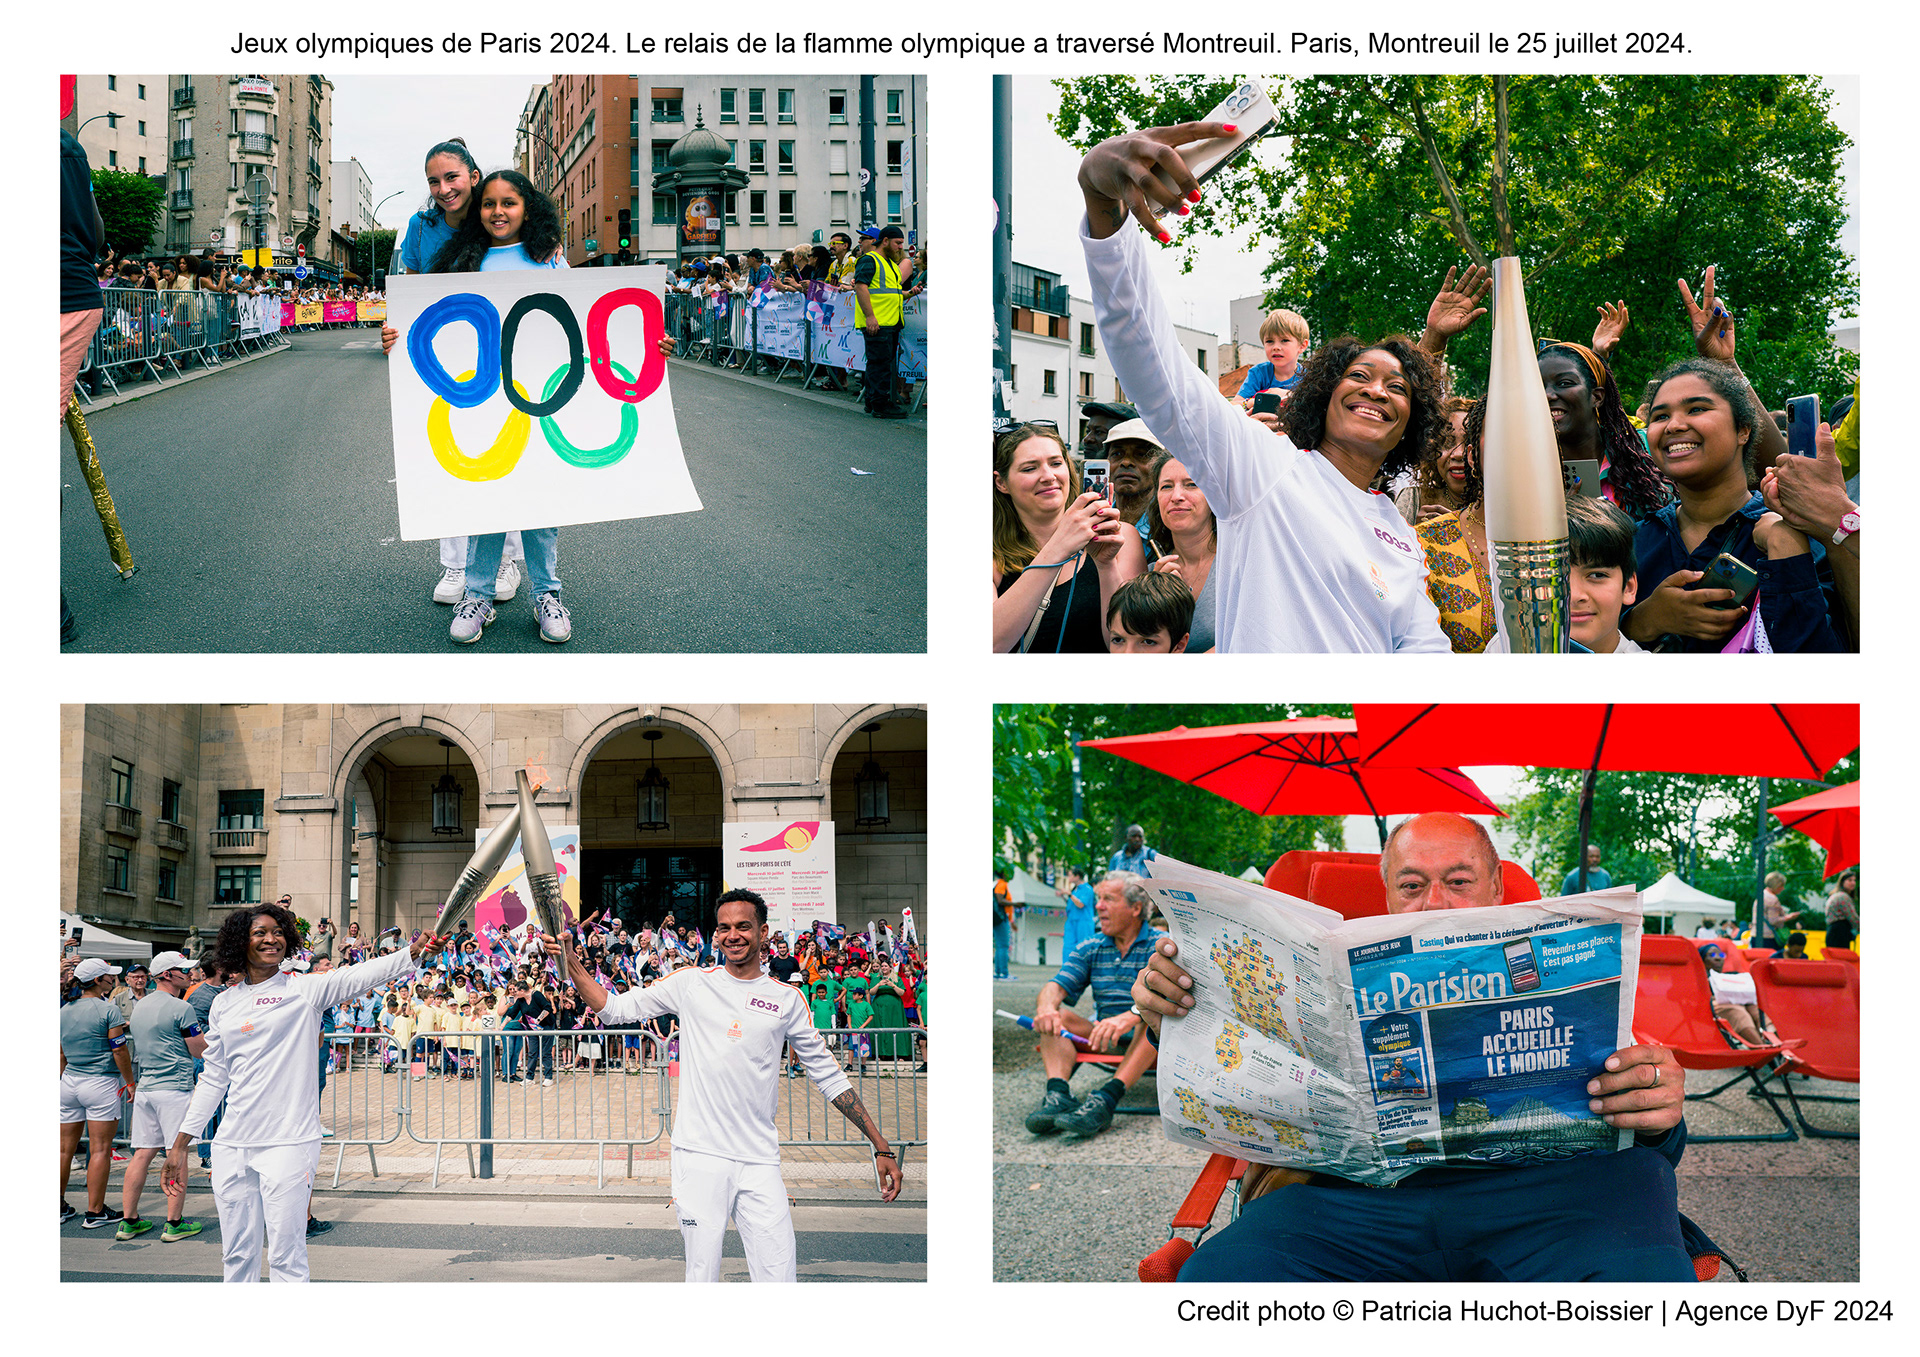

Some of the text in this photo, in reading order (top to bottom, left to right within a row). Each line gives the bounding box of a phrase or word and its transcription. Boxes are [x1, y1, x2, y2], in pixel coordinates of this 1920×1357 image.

[1420, 938, 1444, 948] Casting
[1445, 935, 1455, 945] Qui
[1464, 932, 1489, 942] chanter
[1490, 931, 1494, 940] à
[1494, 930, 1501, 939] la
[1502, 926, 1533, 938] cérémonie
[1534, 920, 1569, 932] d'ouverture
[1569, 917, 1574, 926] ?
[1360, 947, 1380, 957] JOURNAL
[1380, 944, 1389, 952] DES
[1390, 941, 1401, 950] JEUX
[1542, 935, 1616, 956] Revendre ses places,
[1543, 948, 1596, 967] c'est pas gagné
[1360, 968, 1506, 1015] Le Parisien
[1390, 1023, 1409, 1032] Votre
[1500, 1005, 1554, 1031] PARIS
[1373, 1031, 1410, 1044] supplément
[1378, 1040, 1411, 1052] olympique
[1483, 1025, 1574, 1056] ACCUEILLE
[1487, 1048, 1571, 1078] LE MONDE
[1408, 1106, 1432, 1114] barrière
[1411, 1119, 1428, 1127] divise
